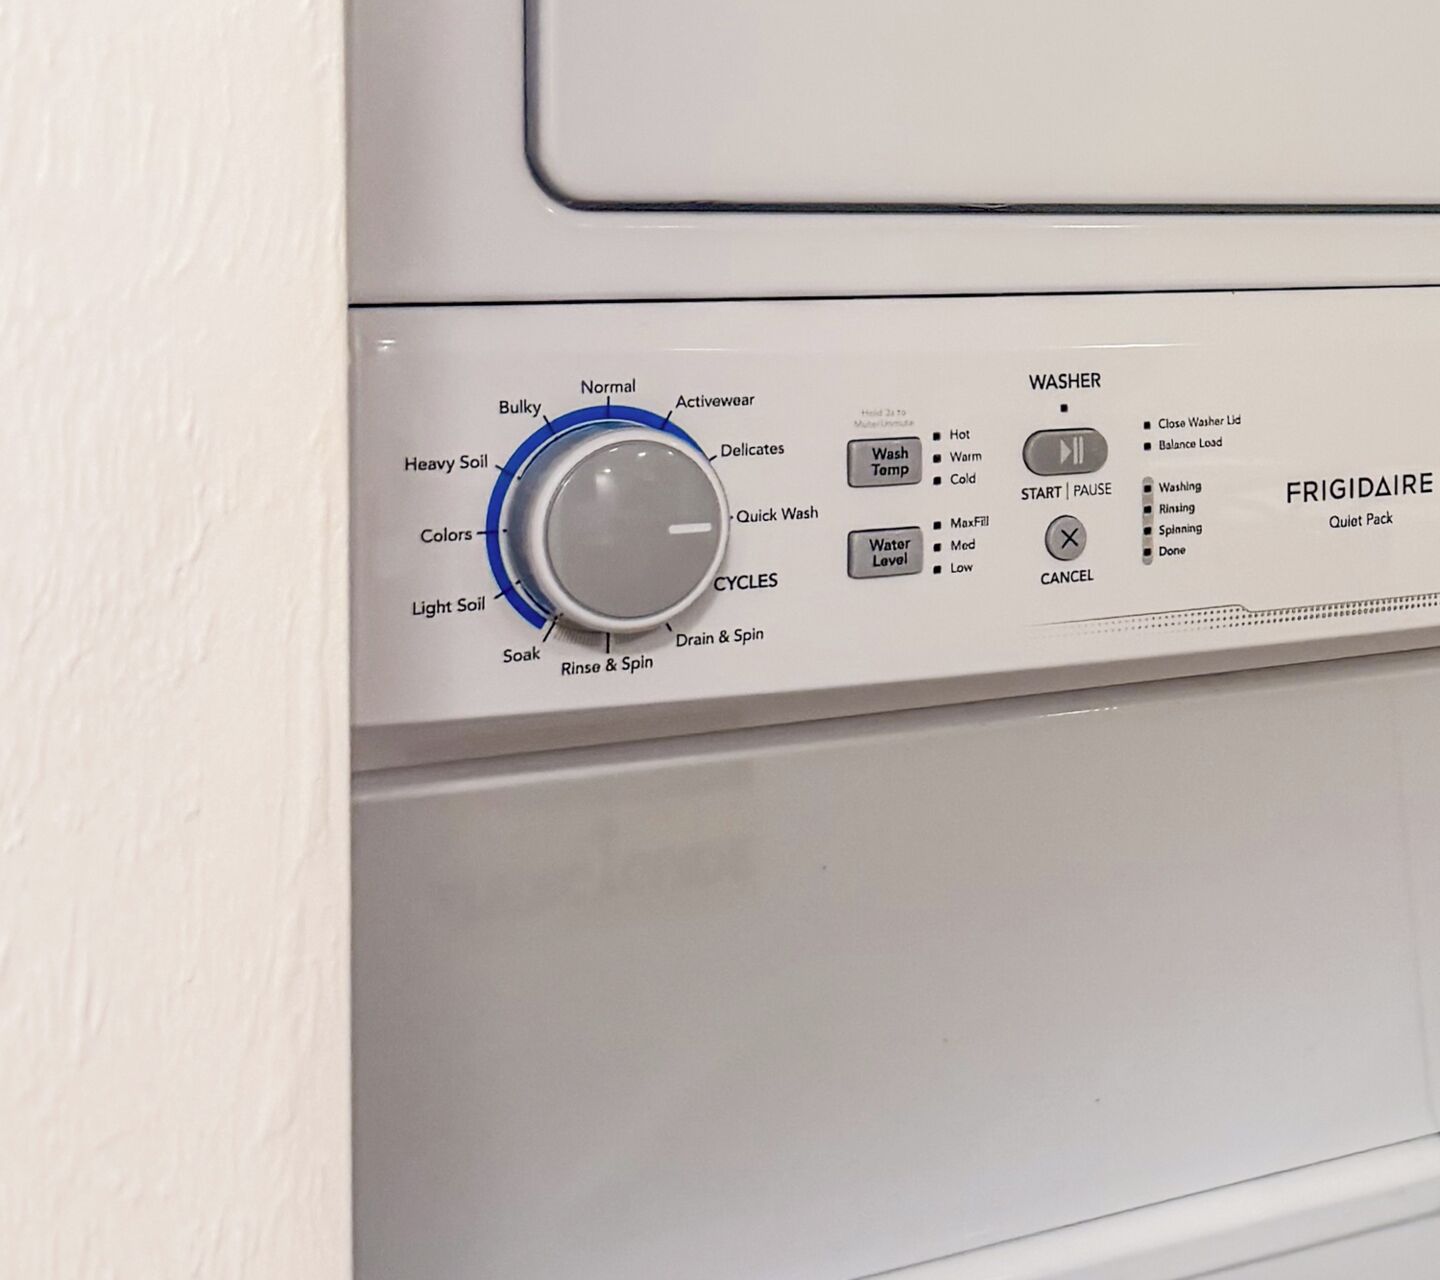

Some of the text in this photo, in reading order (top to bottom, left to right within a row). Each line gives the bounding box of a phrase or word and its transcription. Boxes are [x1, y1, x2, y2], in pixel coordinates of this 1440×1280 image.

[582, 379, 635, 394] Normal
[1029, 373, 1100, 389] WASHER
[500, 399, 541, 417] Bulky
[676, 395, 754, 408] Activewear
[1159, 415, 1241, 429] Close Washer Lid
[950, 429, 969, 439] Hot
[721, 443, 784, 457] Delicates
[1159, 437, 1222, 450] Balance Load
[872, 446, 909, 461] Wash
[950, 452, 981, 462] Warm
[405, 454, 487, 474] Heavy Soil
[871, 463, 910, 479] Temp
[951, 473, 976, 485] Cold
[1022, 483, 1111, 500] START PAUSE
[1159, 482, 1201, 493] Washing
[1288, 473, 1432, 503] FRIGIDAIRE
[737, 506, 818, 523] Quick Wash
[1160, 503, 1195, 514] Rinsing
[951, 516, 989, 528] MaxFill
[1329, 511, 1392, 528] Quiet Pack
[421, 527, 472, 543] Colors
[1159, 525, 1202, 537] Spinning
[869, 538, 911, 552] Water
[951, 539, 975, 550] Med
[1159, 546, 1186, 556] Done
[872, 553, 908, 569] Level
[951, 563, 973, 573] Low
[714, 573, 779, 592] CYCLES
[1041, 569, 1093, 585] CANCEL
[413, 596, 485, 618] Light Soil
[676, 628, 763, 647] Drain & Spin
[504, 646, 540, 663] Soak
[562, 655, 653, 675] Rinse & Spin
